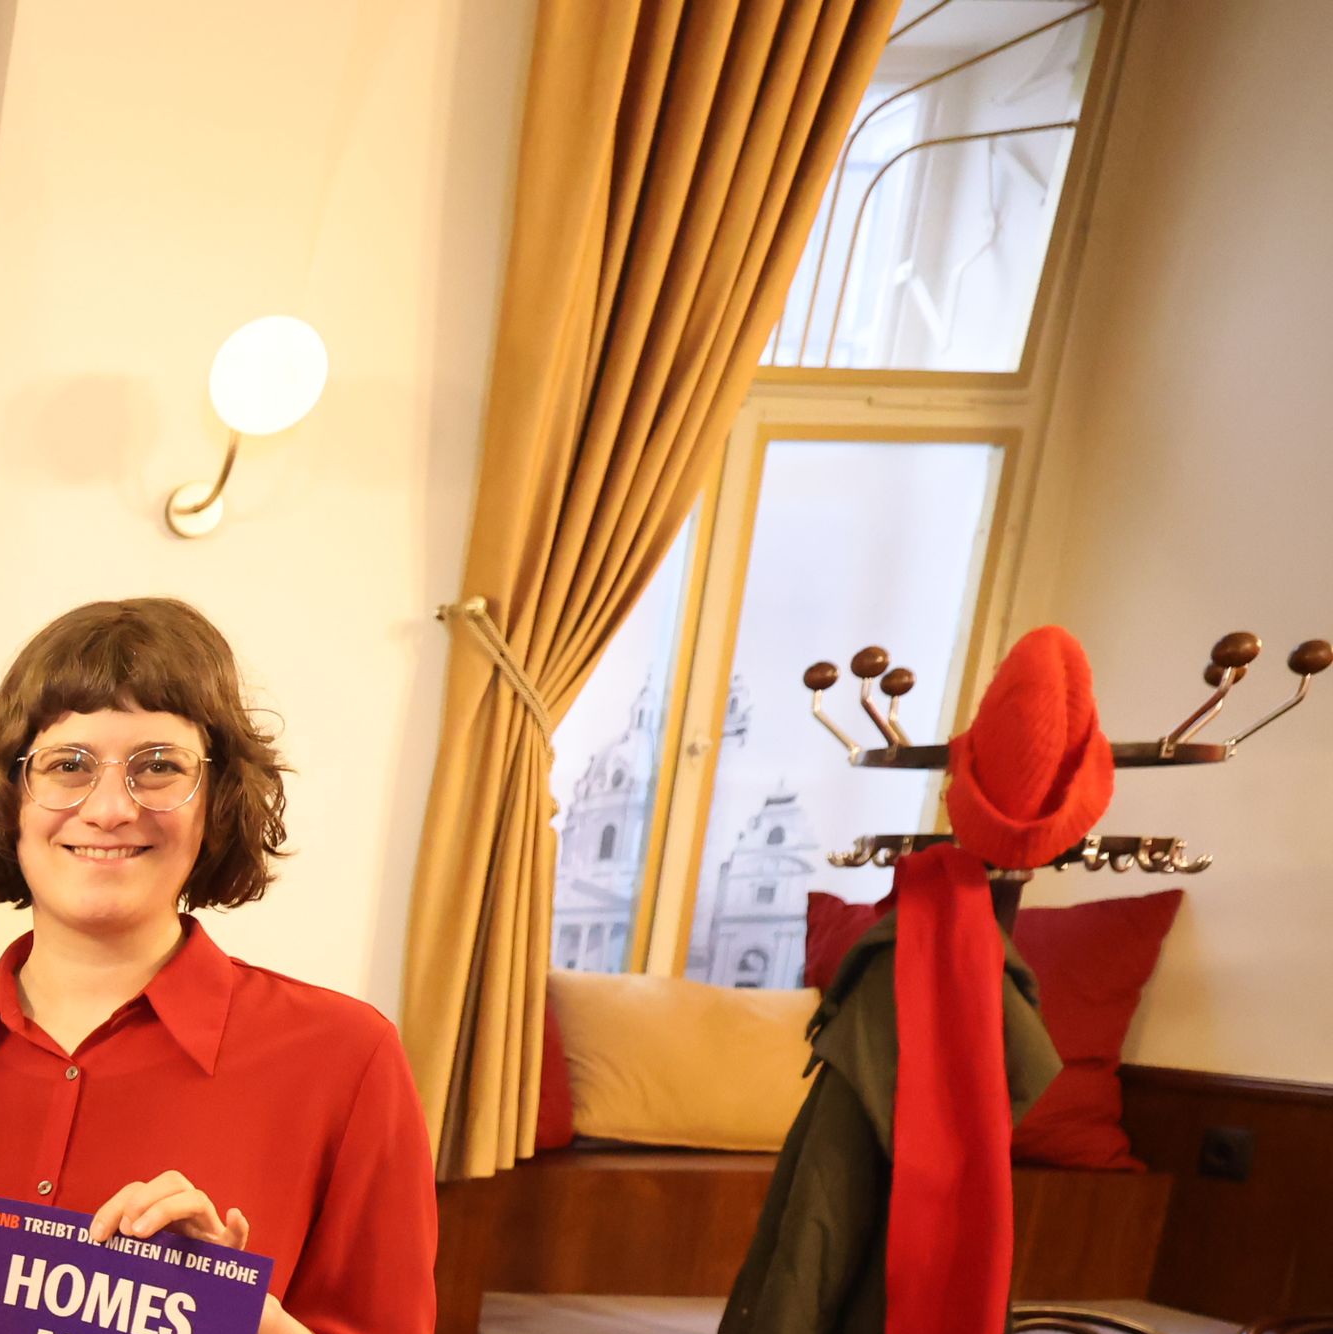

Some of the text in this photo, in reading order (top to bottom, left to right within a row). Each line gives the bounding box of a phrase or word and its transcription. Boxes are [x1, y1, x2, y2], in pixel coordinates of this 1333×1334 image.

[24, 1217, 76, 1240] TREIBT
[105, 1234, 160, 1261] MIETEN
[164, 1247, 183, 1266] IN
[185, 1252, 212, 1273] DIE
[214, 1260, 259, 1286] HÖHE
